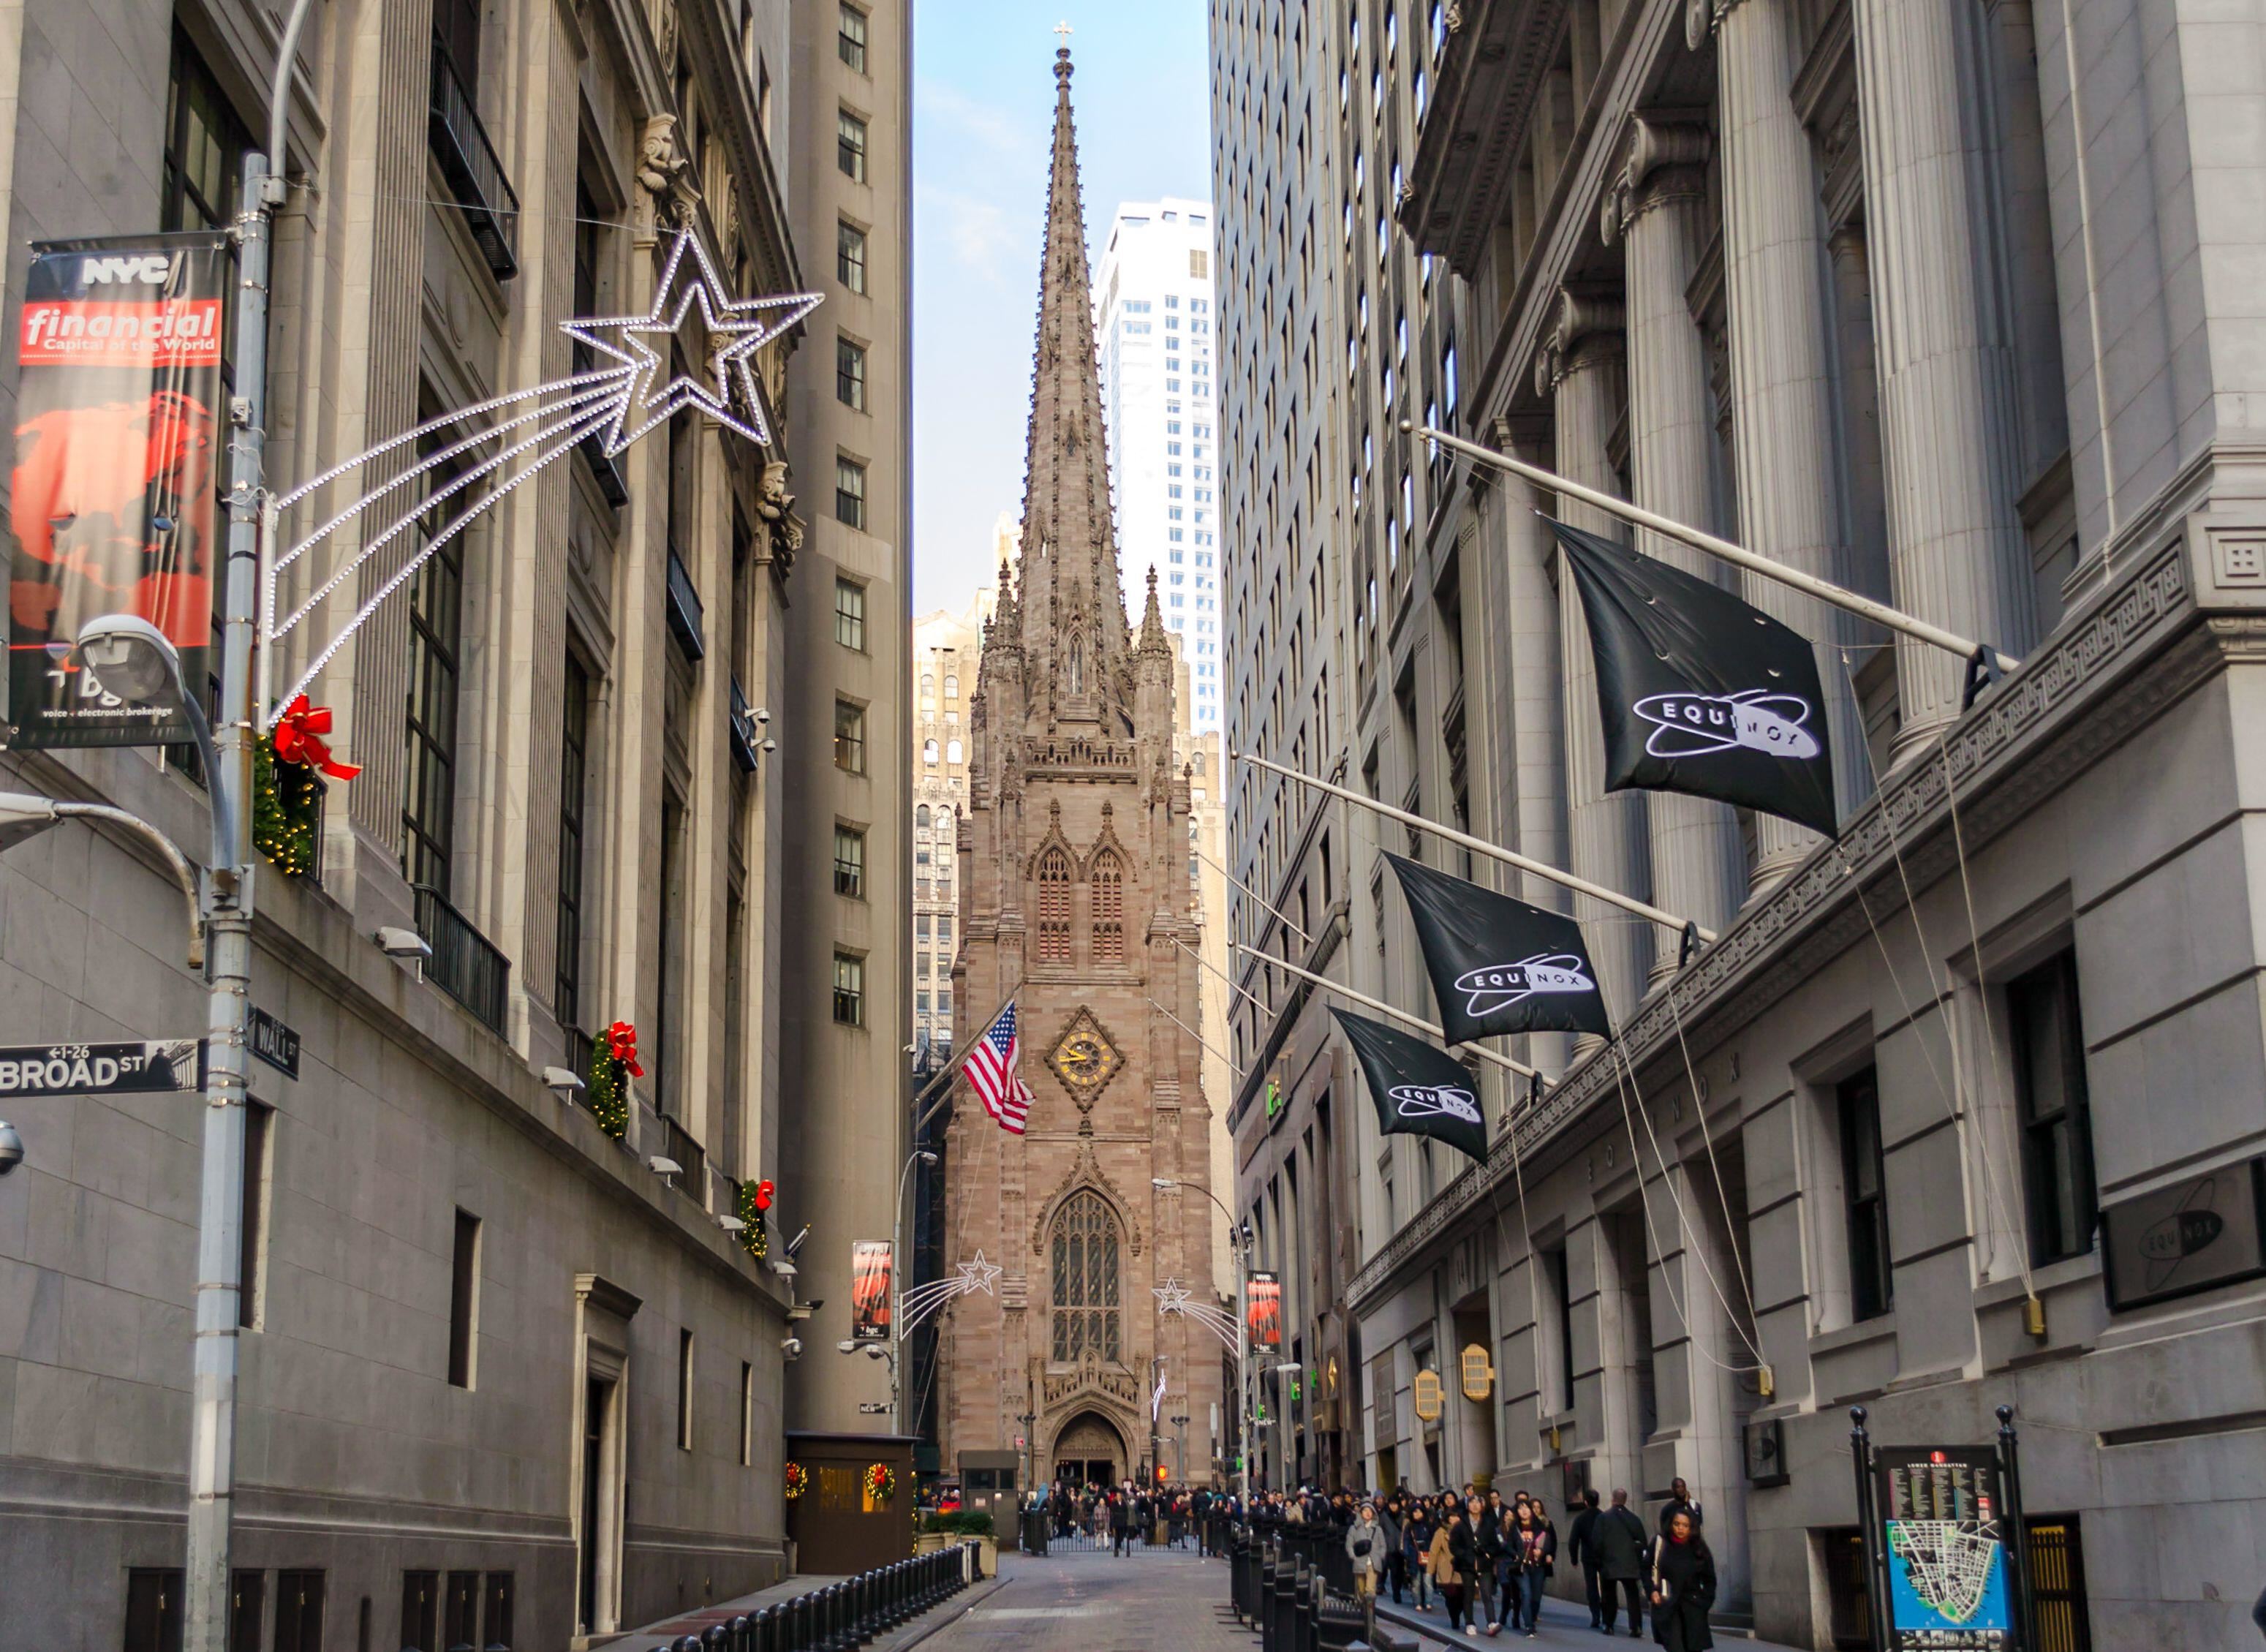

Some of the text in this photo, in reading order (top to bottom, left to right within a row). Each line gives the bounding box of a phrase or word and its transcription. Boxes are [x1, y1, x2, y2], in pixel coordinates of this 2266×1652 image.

[83, 257, 169, 284] NYC
[28, 307, 216, 346] financial
[44, 337, 104, 352] Capital
[110, 338, 128, 351] of
[164, 338, 215, 351] World
[42, 709, 68, 718] voice
[78, 708, 125, 717] electronic
[126, 706, 173, 718] brokerage
[1474, 973, 1579, 987] EQUINOX
[61, 1046, 90, 1060] 1-26
[260, 1022, 289, 1065] WALL
[0, 1056, 144, 1090] BROAD ST
